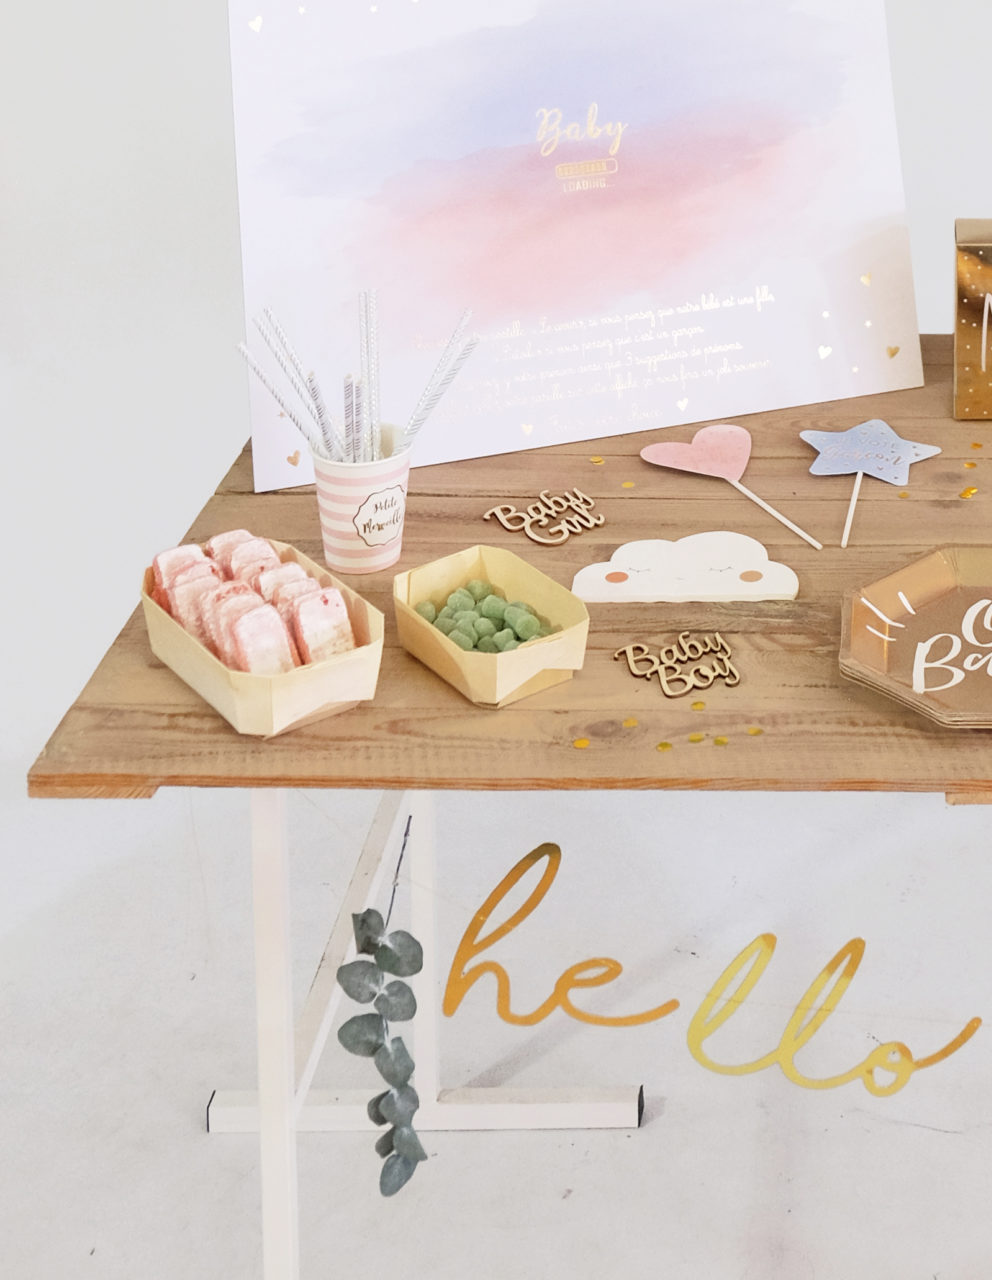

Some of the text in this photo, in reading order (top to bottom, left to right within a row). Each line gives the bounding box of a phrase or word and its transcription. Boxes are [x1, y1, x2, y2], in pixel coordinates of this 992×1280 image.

[534, 101, 629, 156] Baby
[484, 487, 596, 533] Baby
[614, 630, 733, 682] Baby
[658, 654, 741, 699] Boy
[443, 841, 984, 1097] hello
